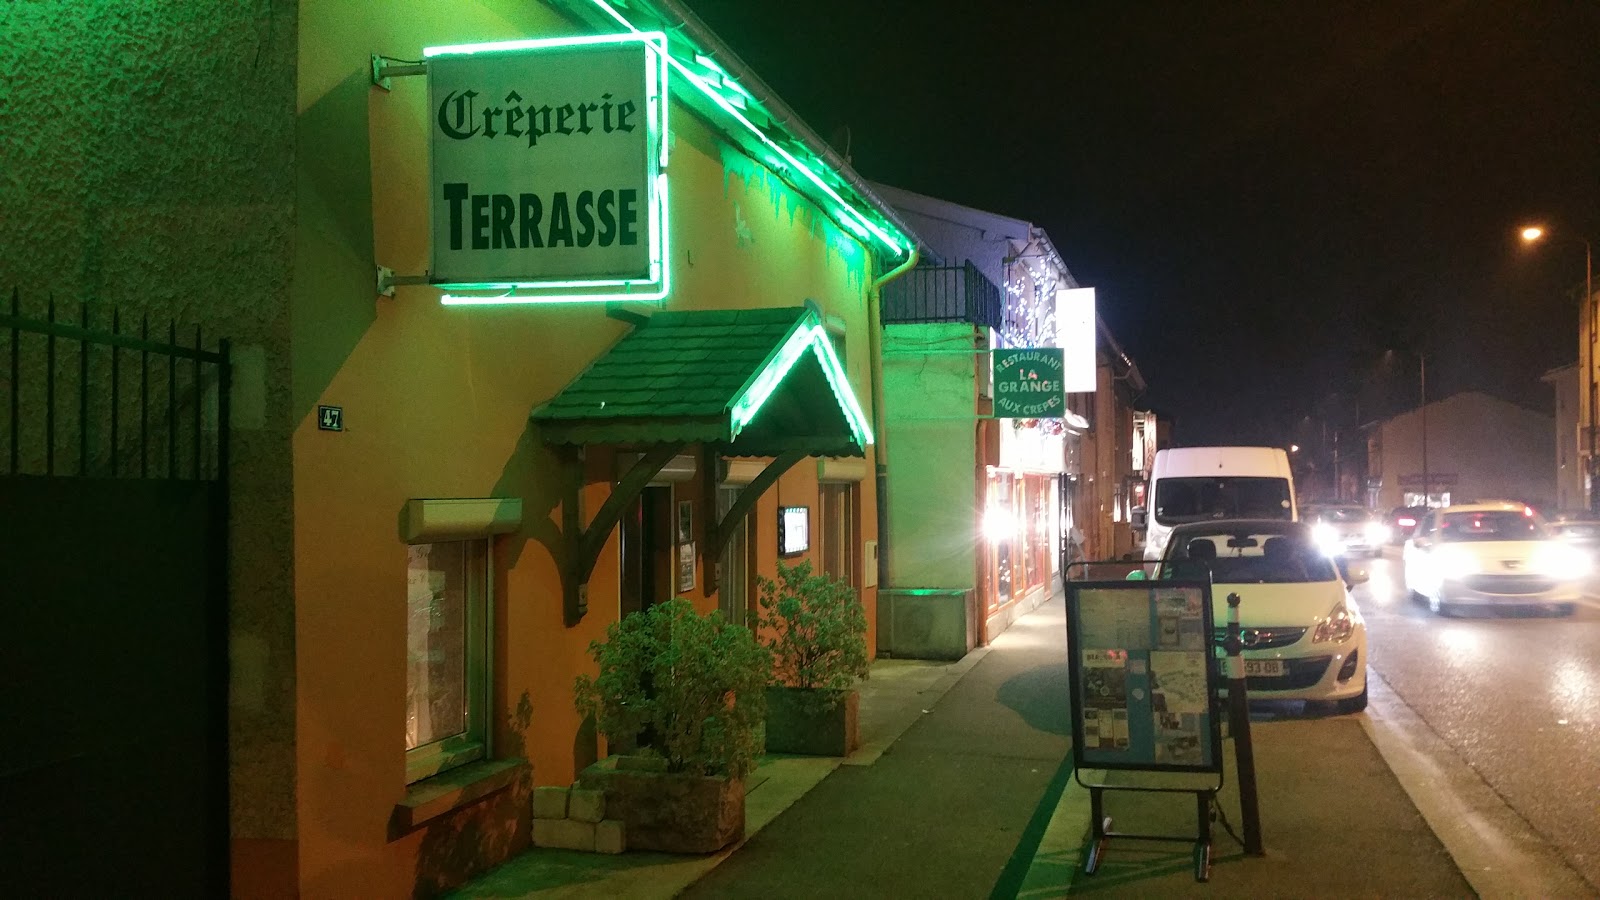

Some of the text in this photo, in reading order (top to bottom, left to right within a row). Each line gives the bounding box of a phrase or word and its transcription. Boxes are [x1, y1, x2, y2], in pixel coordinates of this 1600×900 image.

[438, 89, 637, 149] Crêperie
[443, 183, 638, 251] TERRASSE
[995, 351, 1062, 373] RESTAURANT
[1019, 368, 1038, 381] LA
[998, 380, 1060, 393] GRANGE
[998, 395, 1061, 415] AUX CREPES
[323, 409, 340, 427] 47
